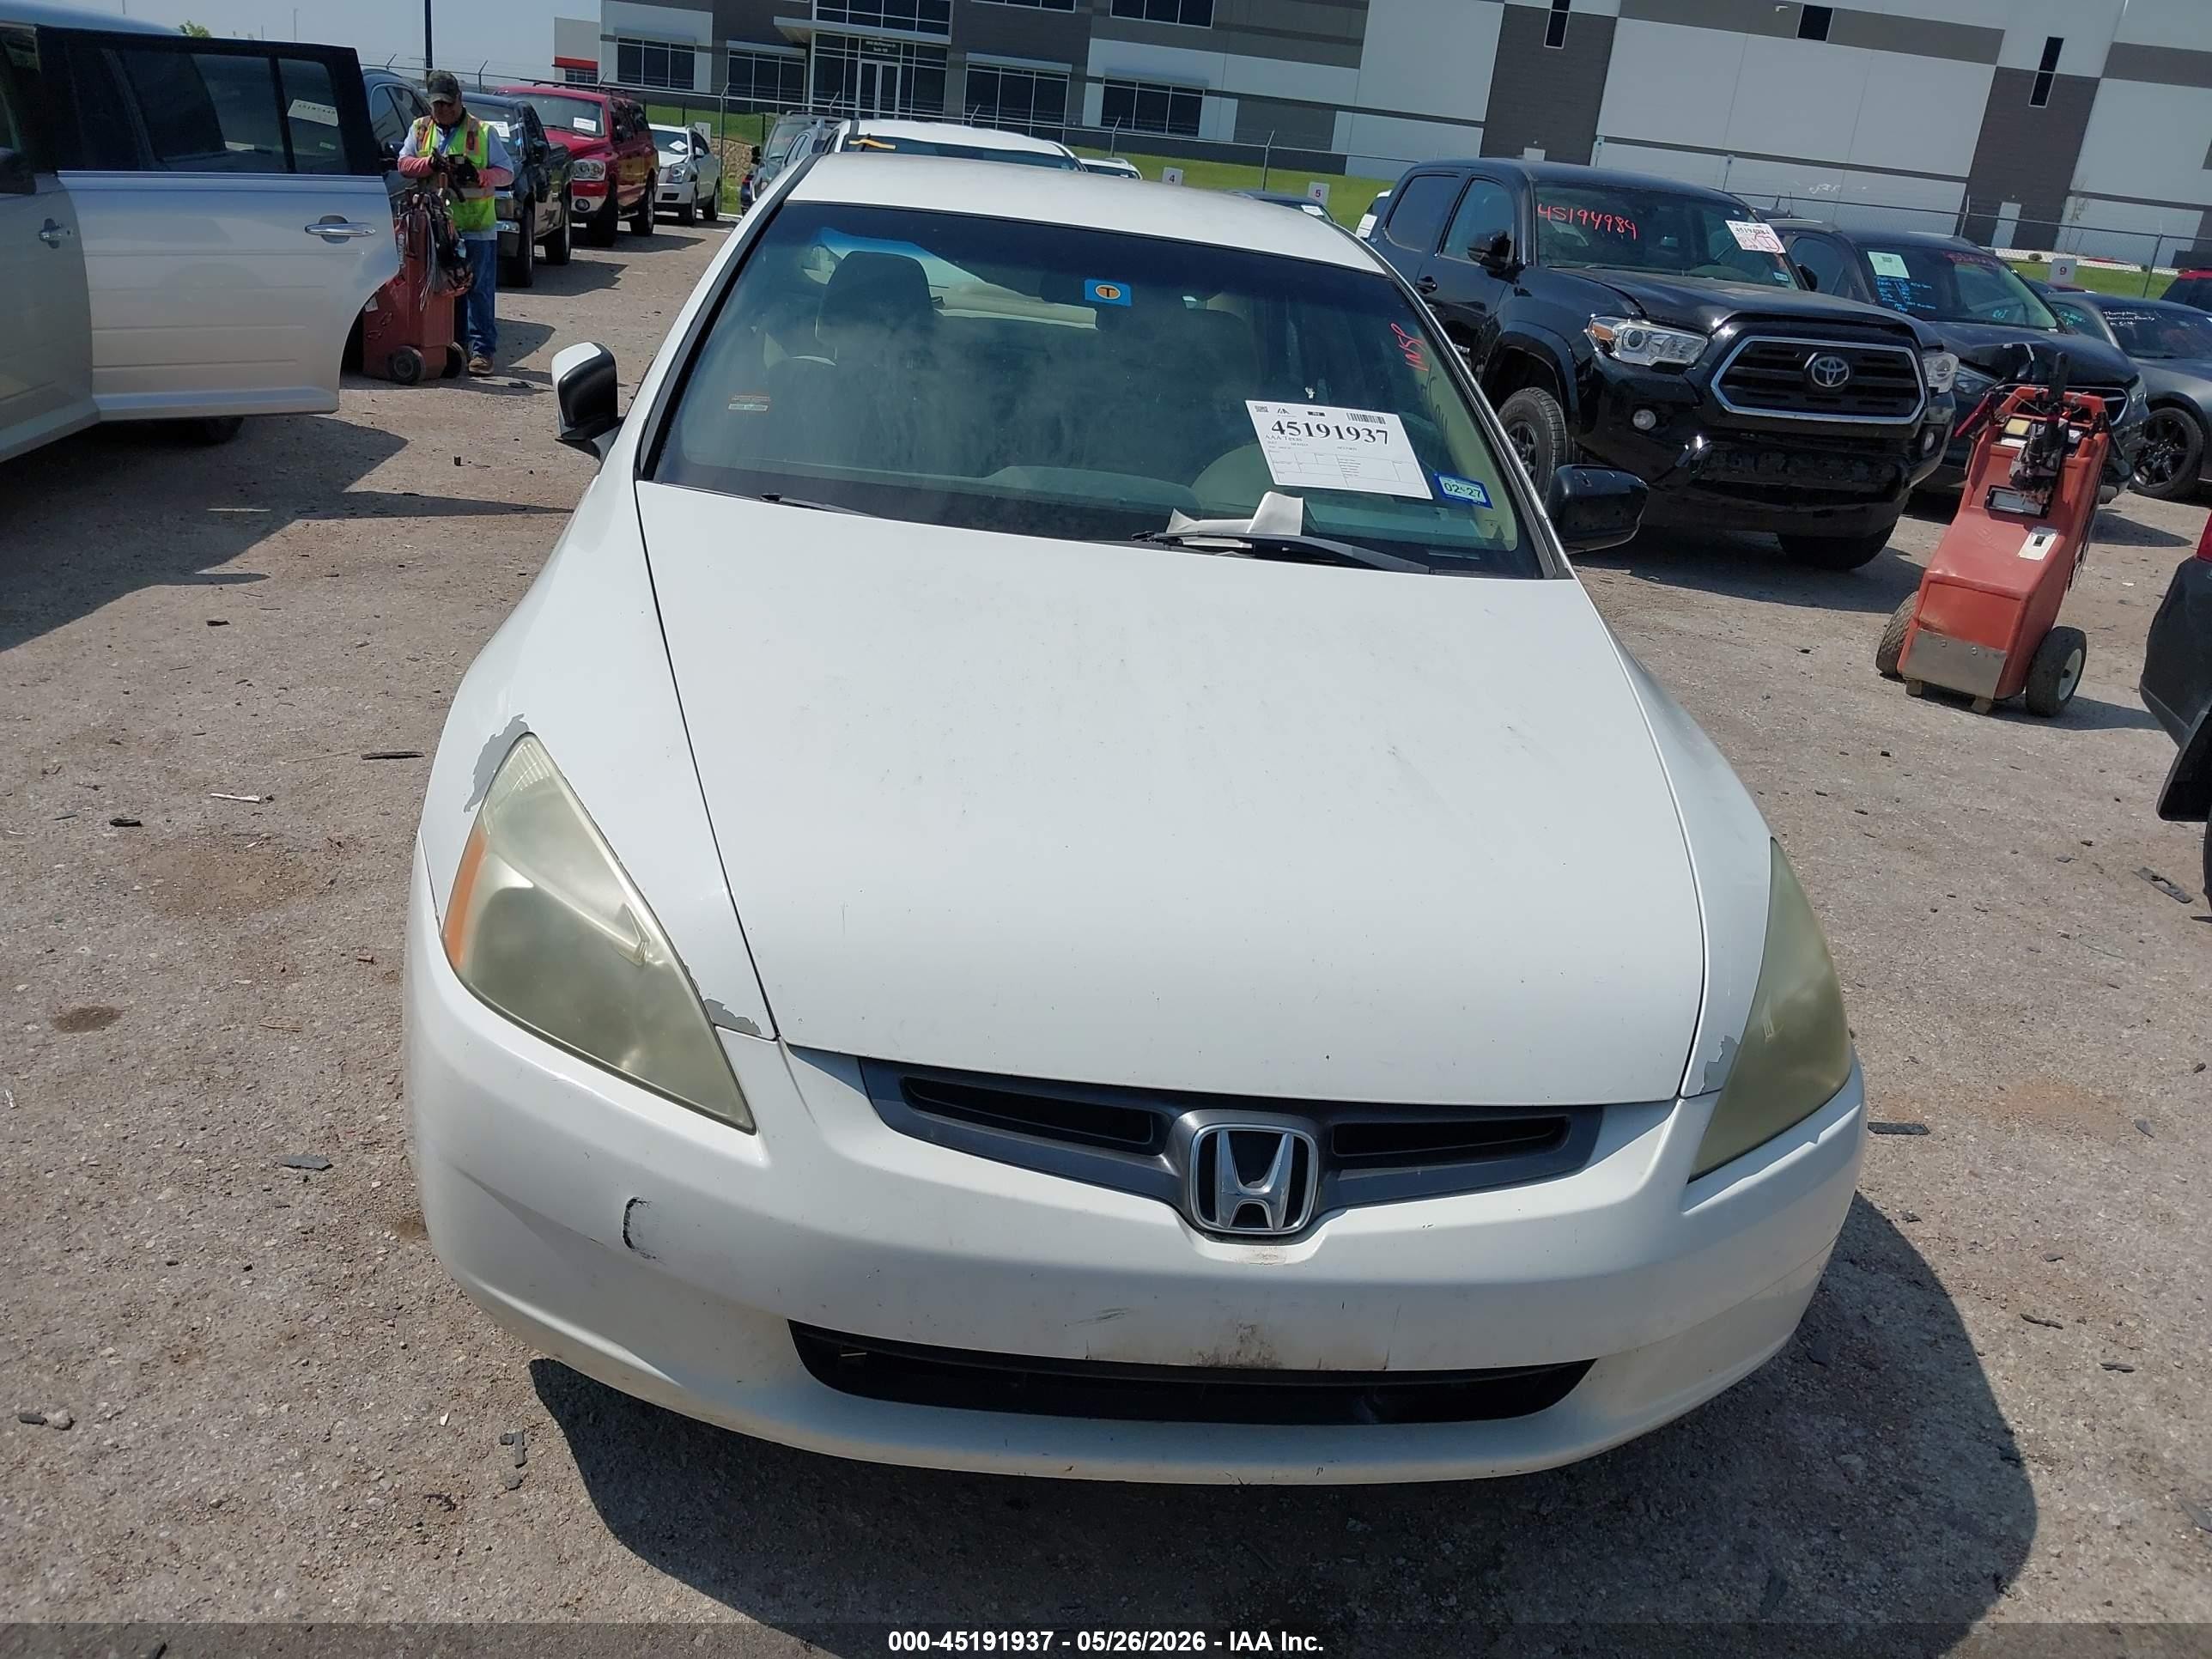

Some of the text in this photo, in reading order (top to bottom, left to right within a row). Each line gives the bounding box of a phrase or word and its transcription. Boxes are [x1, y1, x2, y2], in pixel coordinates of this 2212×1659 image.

[1168, 174, 1176, 183] 4
[1315, 189, 1322, 198] 5
[1537, 203, 1637, 240] 45194984
[2059, 266, 2067, 275] 9
[1271, 420, 1389, 445] 45191937
